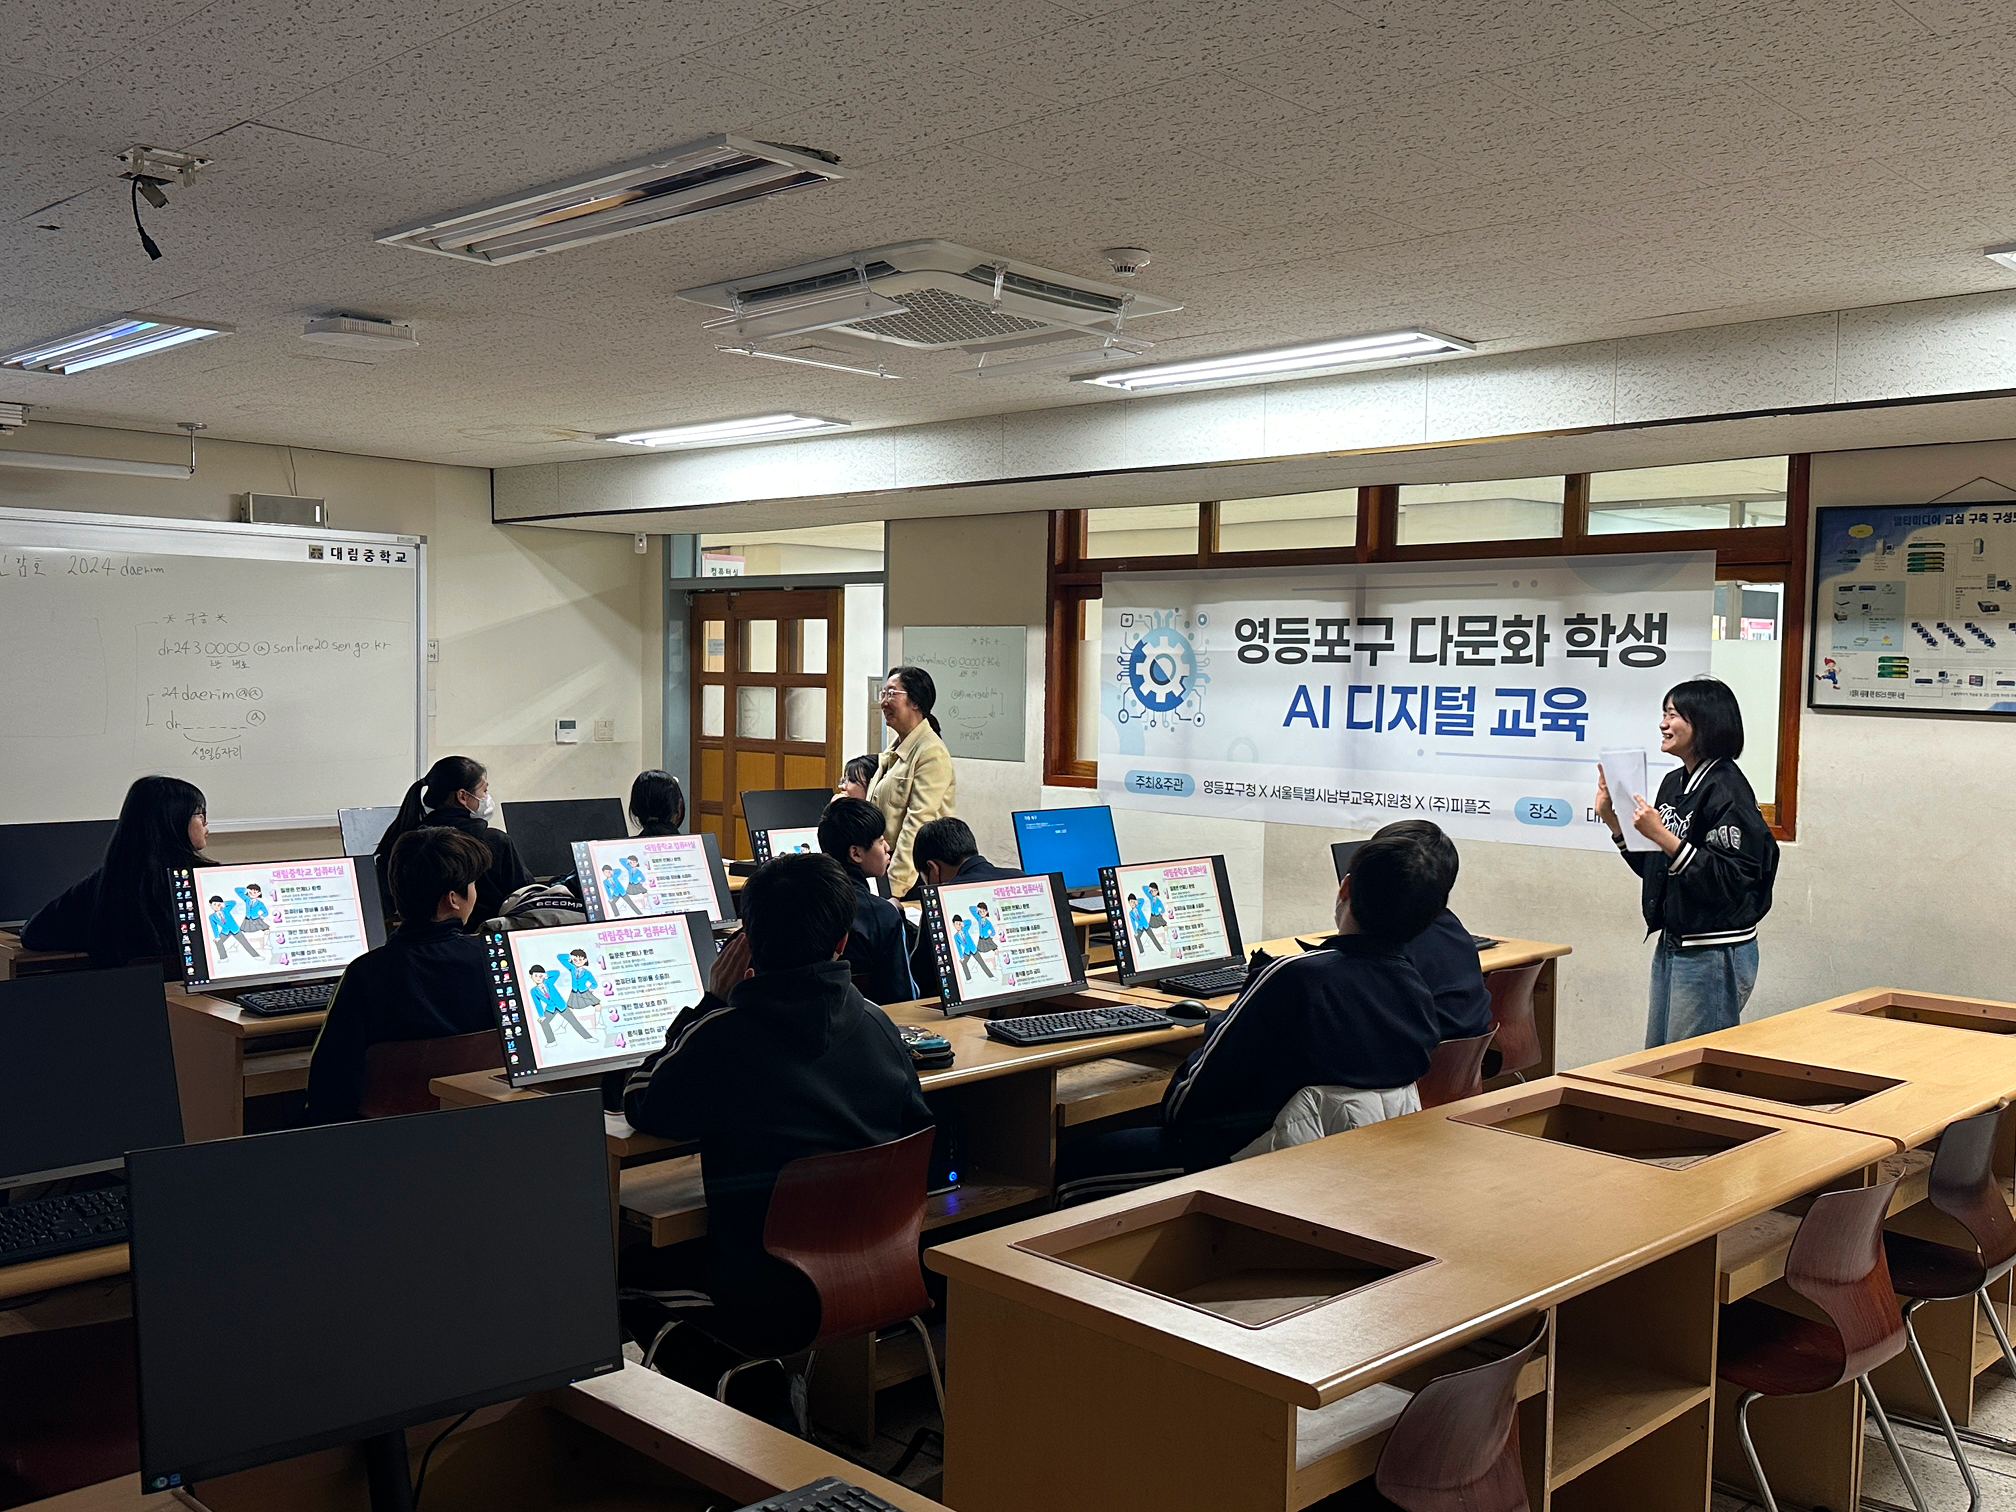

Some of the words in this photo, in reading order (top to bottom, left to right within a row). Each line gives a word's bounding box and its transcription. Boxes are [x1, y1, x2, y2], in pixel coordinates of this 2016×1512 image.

[1944, 513, 1965, 525] 교실
[1969, 512, 1988, 524] 구축
[330, 546, 407, 563] 대림중학교
[1234, 617, 1395, 667] 영등포구
[1409, 614, 1551, 668] 다문화
[1563, 612, 1669, 668] 학생
[1282, 684, 1332, 729] AI
[1345, 684, 1477, 737] 디지털
[1489, 686, 1589, 741] 교육
[1135, 775, 1184, 792] 주최&주관
[1203, 780, 1256, 798] 영등포구청
[1428, 795, 1491, 815] (주)피플즈
[1529, 803, 1558, 820] 장소
[597, 928, 642, 942] 대림중학교
[643, 924, 677, 938] 컴퓨터실
